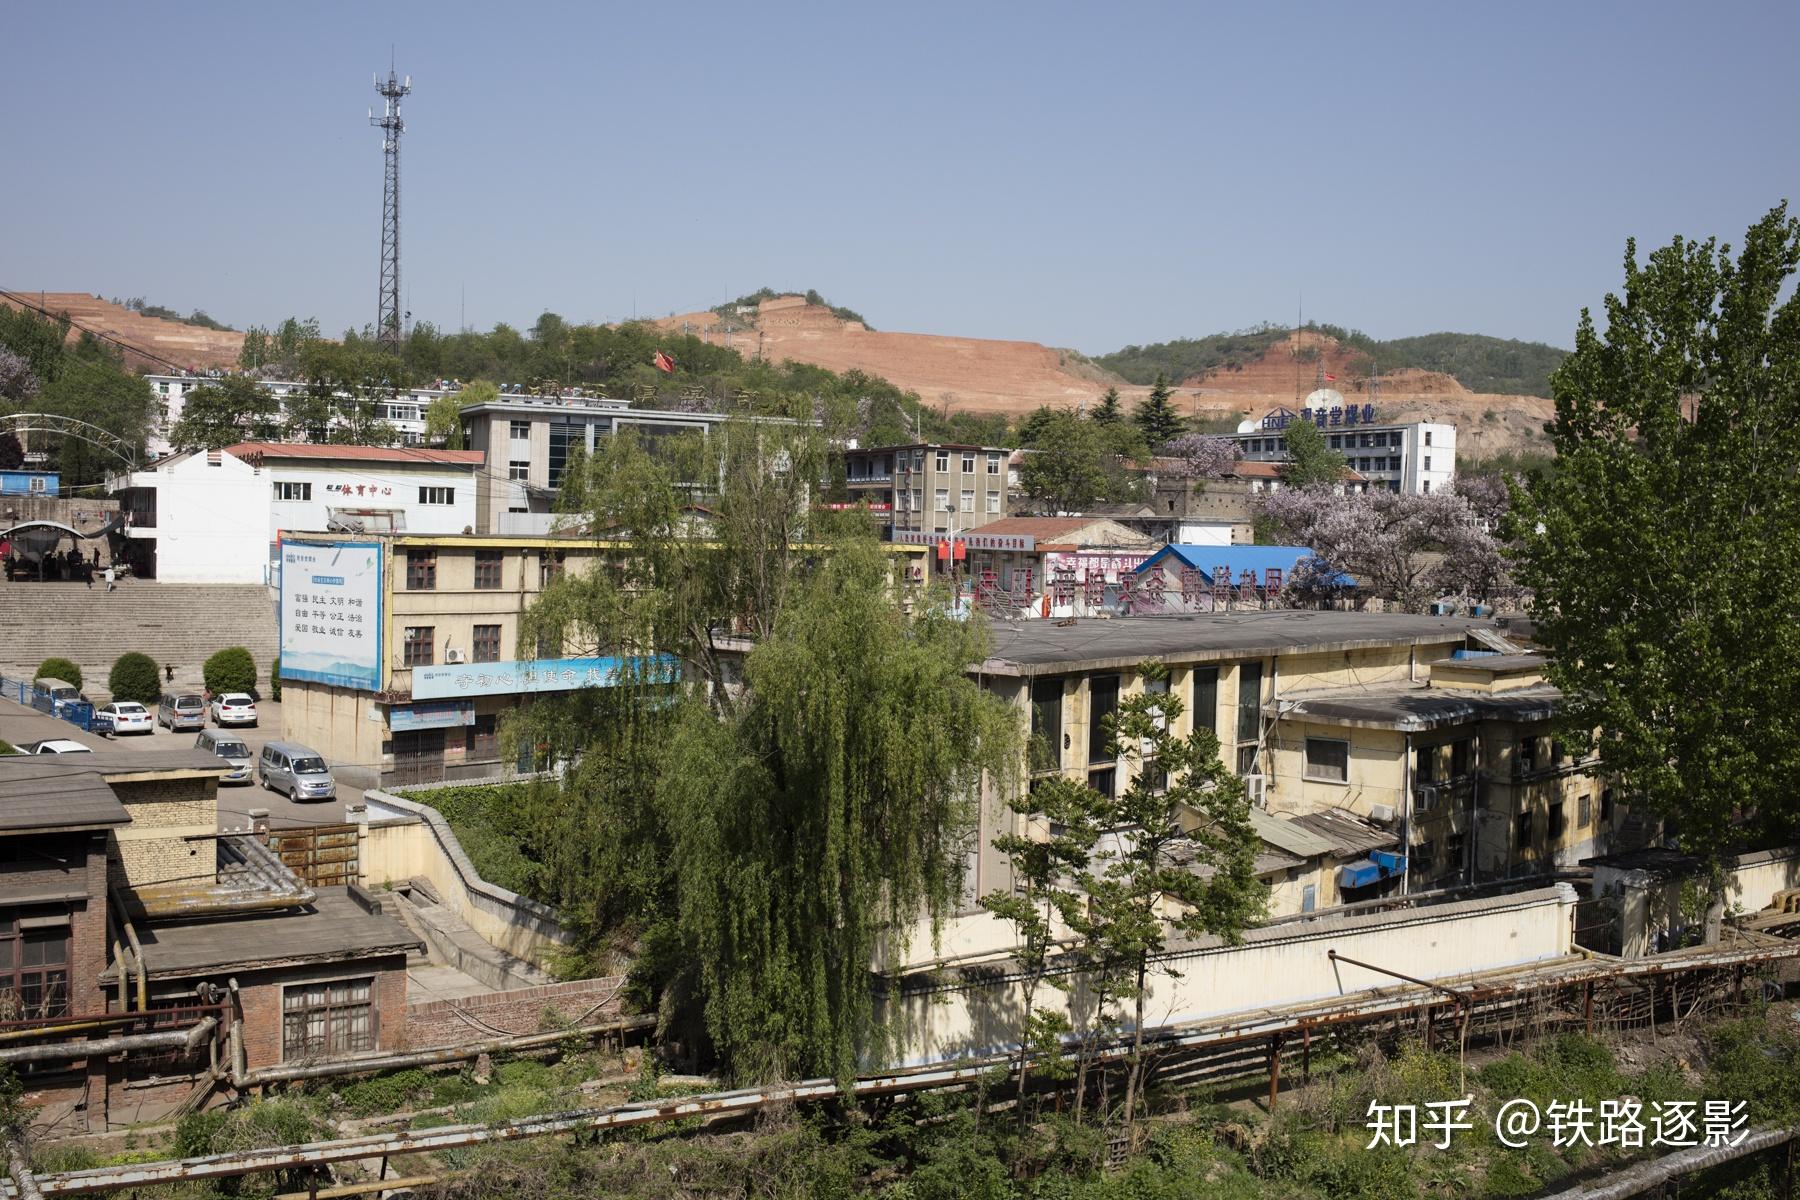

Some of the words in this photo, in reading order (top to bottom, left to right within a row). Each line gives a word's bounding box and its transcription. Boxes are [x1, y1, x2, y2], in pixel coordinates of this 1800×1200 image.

[341, 483, 392, 497] 体育中心
[899, 534, 1025, 549] 人民对美好生活的是我们的奋斗目标
[1065, 557, 1149, 569] 幸福都是奋斗出
[294, 593, 309, 604] 富强
[312, 595, 326, 605] 民主
[329, 597, 344, 606] 文明
[347, 598, 363, 608] 和谐
[294, 609, 308, 618] 自由
[312, 610, 326, 620] 平等
[329, 612, 344, 621] 公正
[347, 613, 363, 623] 法治
[294, 624, 308, 633] 爱国
[312, 625, 326, 635] 敬业
[329, 627, 344, 637] 诚信
[347, 629, 363, 639] 友善
[455, 673, 513, 689] 守初心
